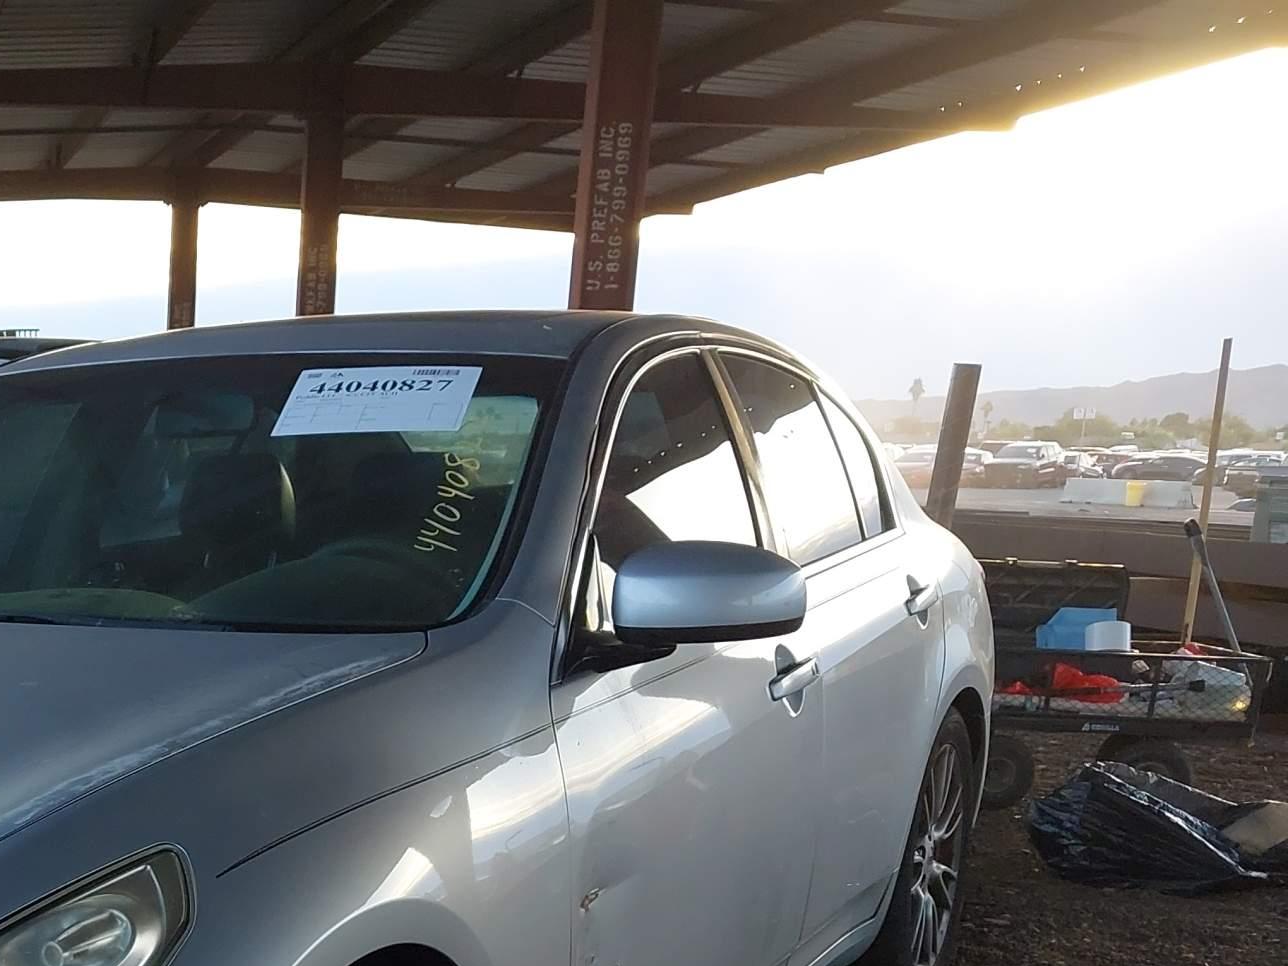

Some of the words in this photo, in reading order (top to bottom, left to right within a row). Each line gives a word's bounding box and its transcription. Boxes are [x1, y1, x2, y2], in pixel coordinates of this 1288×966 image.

[591, 168, 611, 244] PREFAB
[604, 121, 633, 289] 1-866-799-0969
[586, 255, 604, 291] U.S.
[309, 378, 455, 395] 44040827
